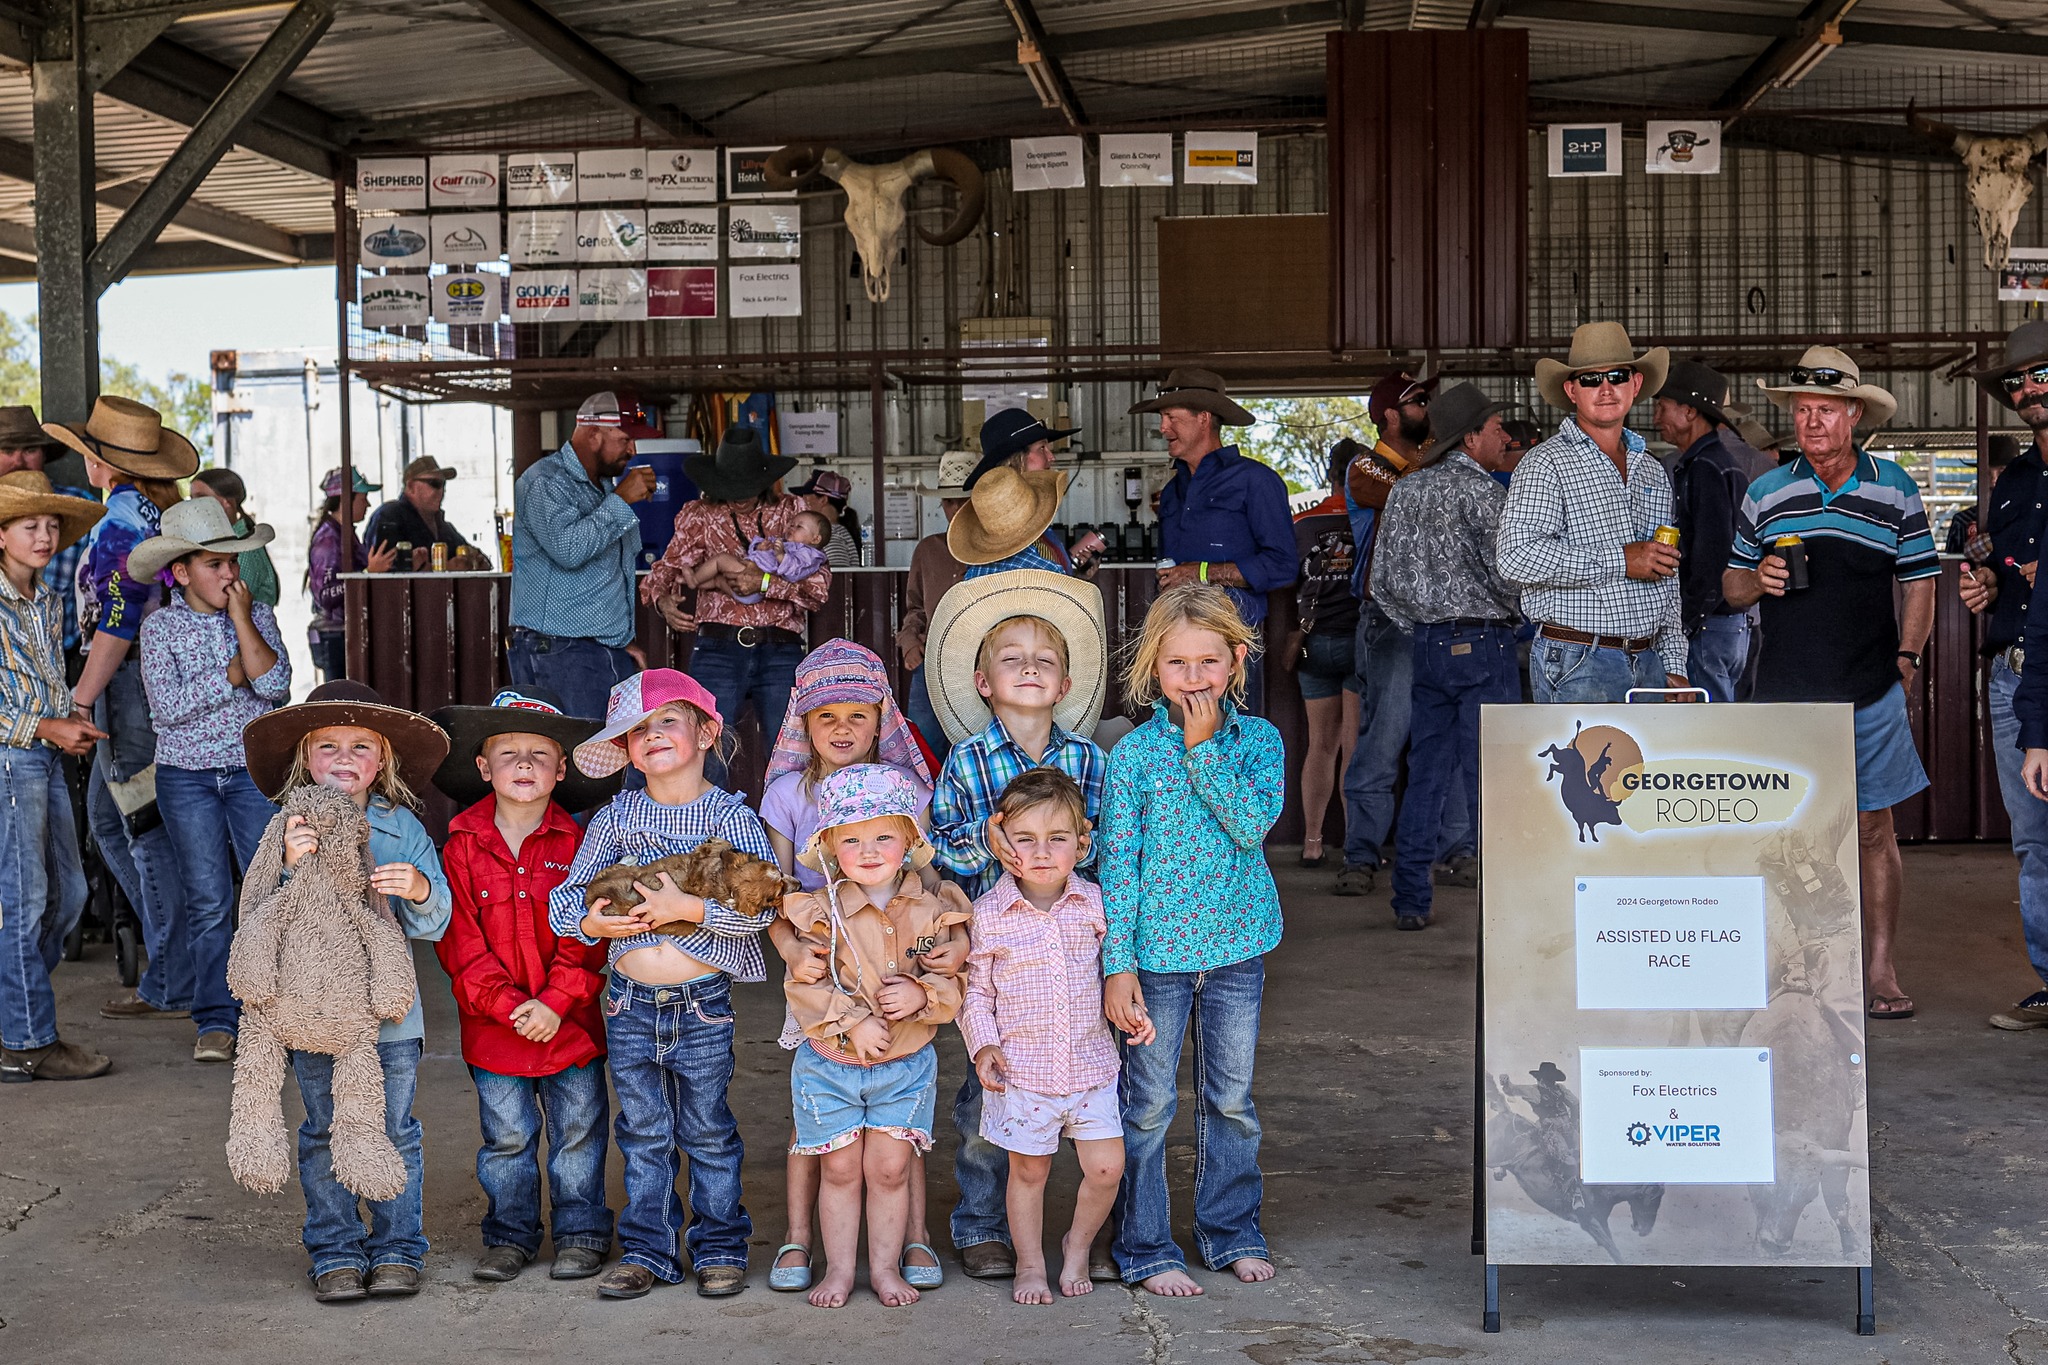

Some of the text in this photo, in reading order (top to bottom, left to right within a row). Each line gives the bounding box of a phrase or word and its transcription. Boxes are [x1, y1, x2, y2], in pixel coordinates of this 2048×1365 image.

[1027, 151, 1067, 160] Georgetown
[1110, 152, 1131, 160] Glenn
[1138, 152, 1161, 160] Cheryl
[1238, 153, 1252, 162] CAT
[1120, 162, 1151, 171] Connolly
[363, 175, 424, 187] SHEPHERD
[440, 175, 487, 187] Gulf Civil
[680, 176, 715, 184] ELECTRICAL
[738, 172, 760, 183] Hotel
[649, 223, 717, 235] COBBOLD GORGE
[577, 235, 614, 248] Genex
[2005, 261, 2048, 273] WILKINS
[739, 272, 790, 282] Fox Electrics
[448, 282, 484, 297] CTS
[516, 285, 570, 297] GOUGH
[362, 289, 428, 304] CURLEY
[518, 298, 569, 307] PLASTICS
[1622, 772, 1790, 791] GEORGETOWN
[1656, 797, 1759, 823] RODEO
[1616, 897, 1719, 907] 2024 Georgetown Rodeo
[1596, 930, 1741, 943] ASSISTED U8 FLAG
[1648, 954, 1691, 968] RACE
[1598, 1069, 1653, 1078] Sponsored by:
[1632, 1084, 1718, 1097] Fox Electrics
[1668, 1108, 1679, 1120] &
[1652, 1124, 1721, 1142] VIPER
